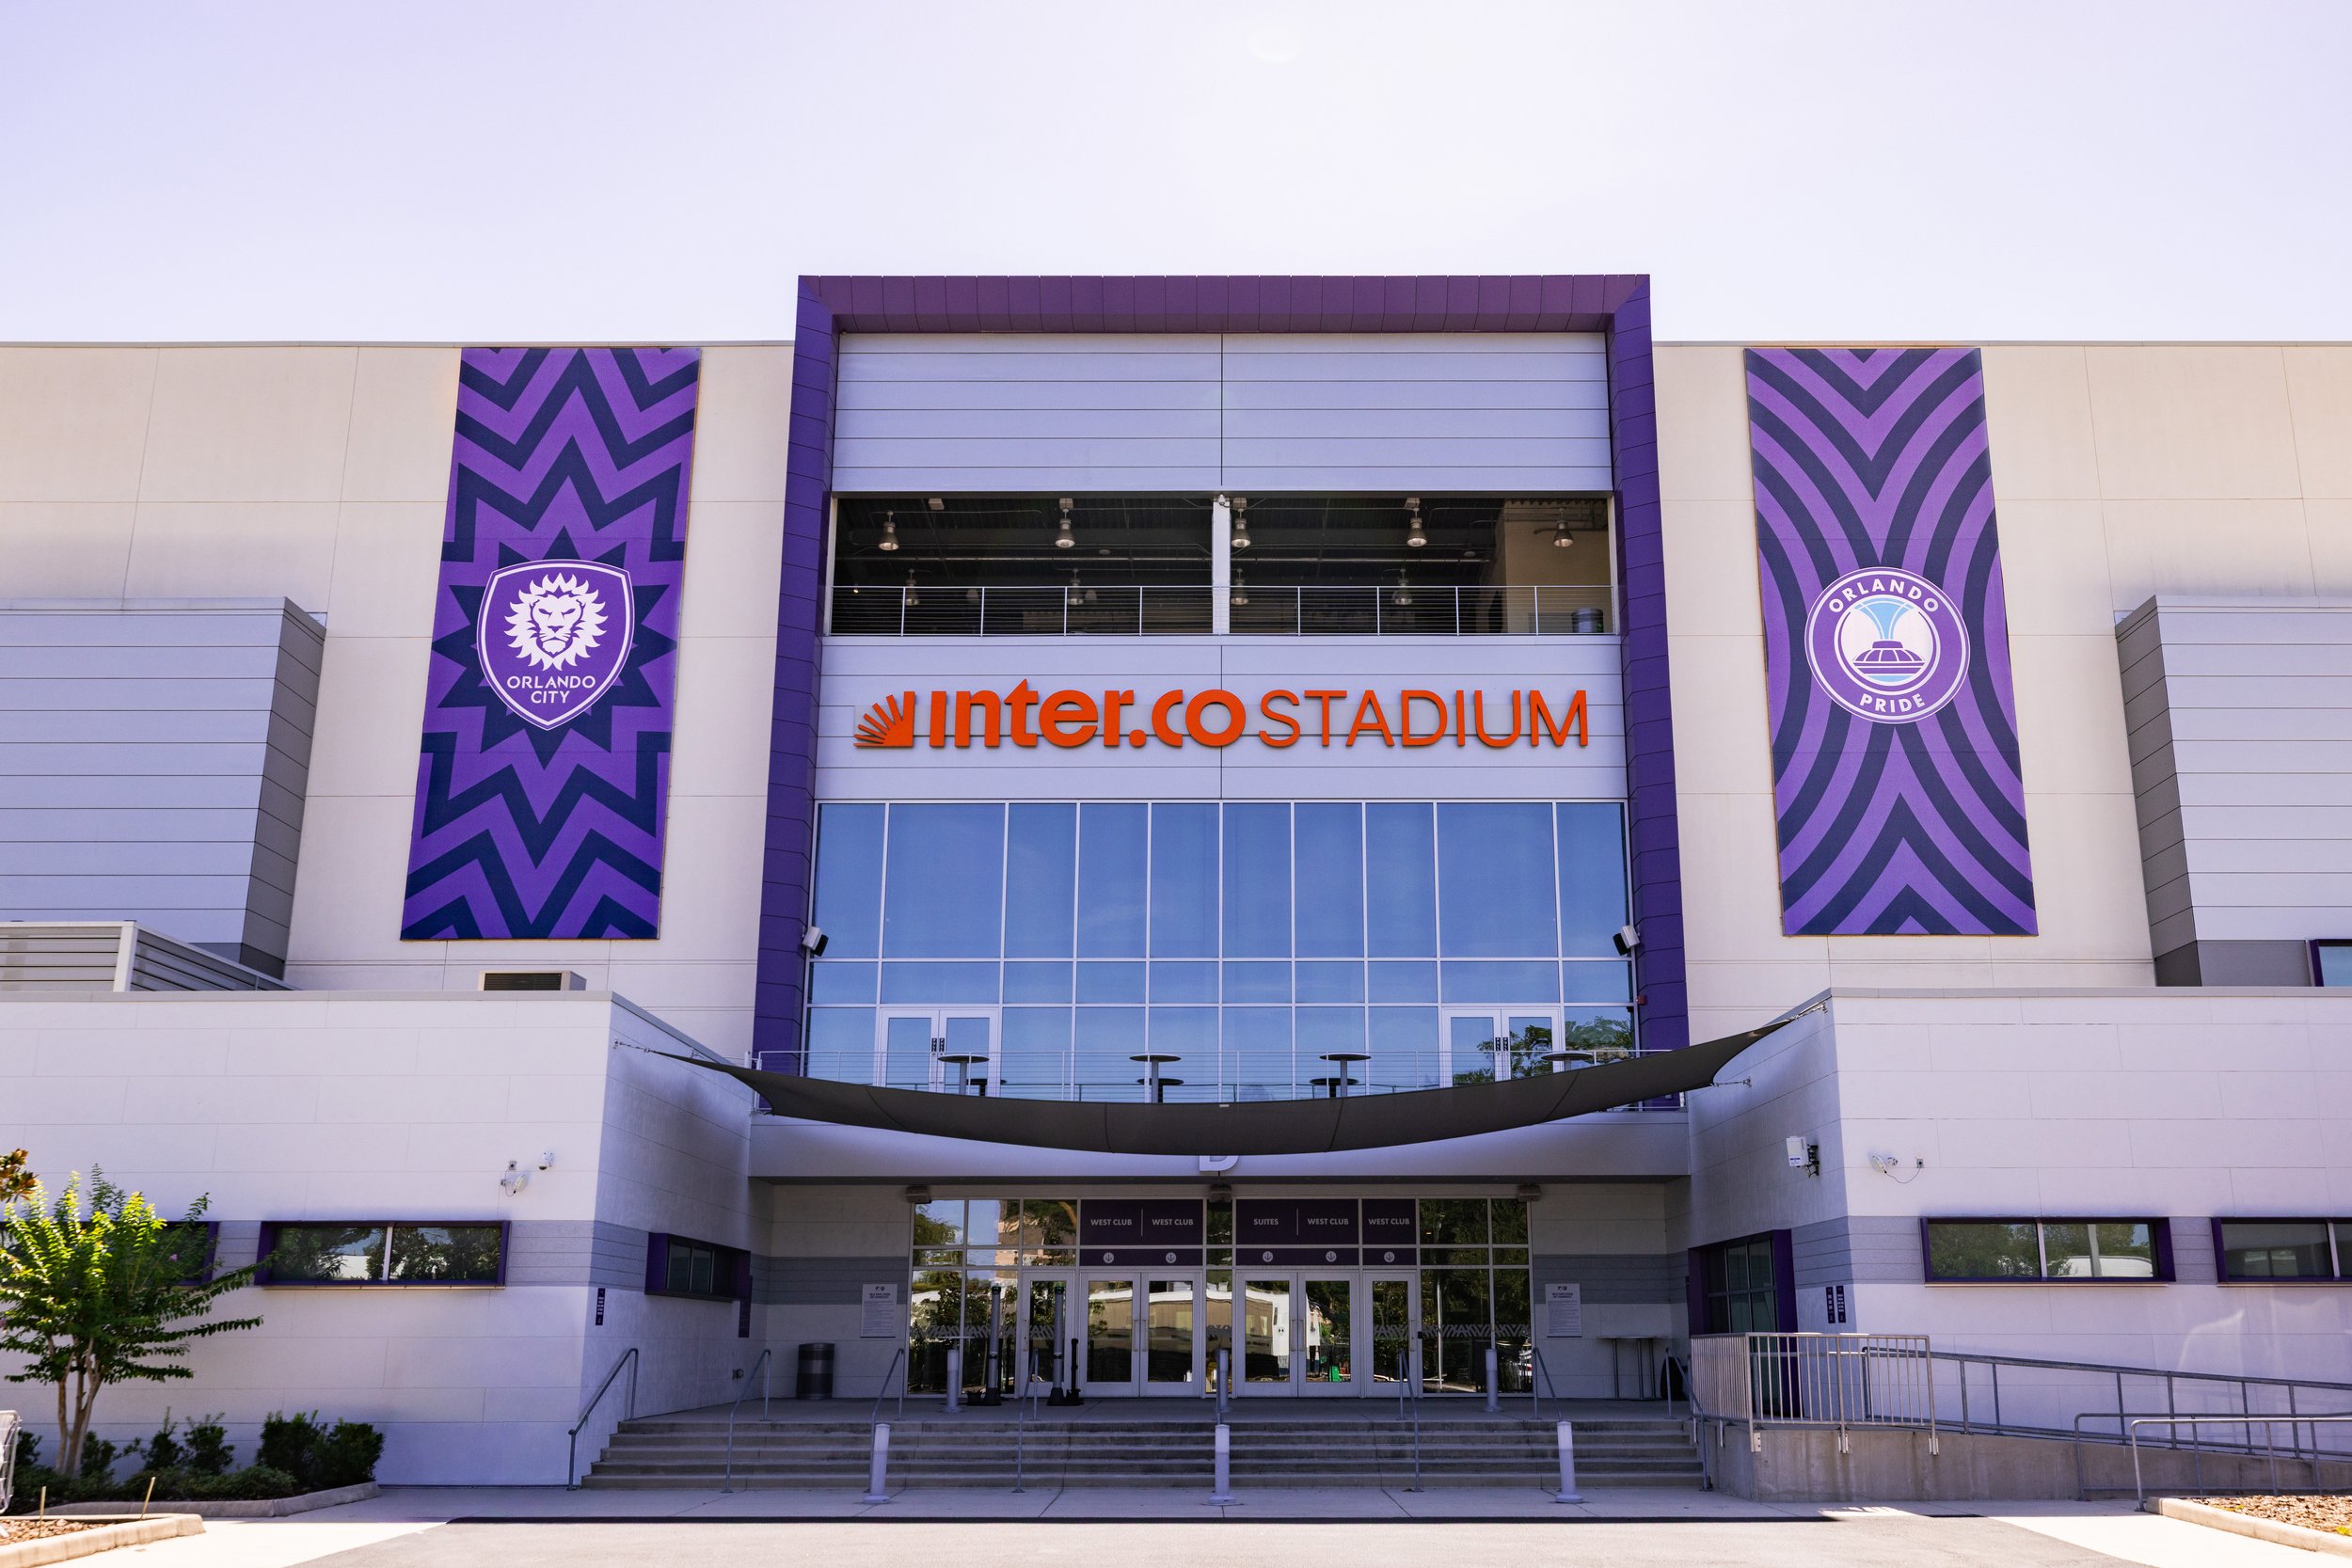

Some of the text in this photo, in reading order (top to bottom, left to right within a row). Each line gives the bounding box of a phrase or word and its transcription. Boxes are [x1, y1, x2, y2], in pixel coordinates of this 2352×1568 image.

[1829, 578, 1939, 613] ORLANDO
[506, 675, 596, 689] ORLANDO
[531, 690, 570, 704] CITY
[1859, 693, 1926, 713] PRIDE
[1259, 689, 1588, 746] STADIUM
